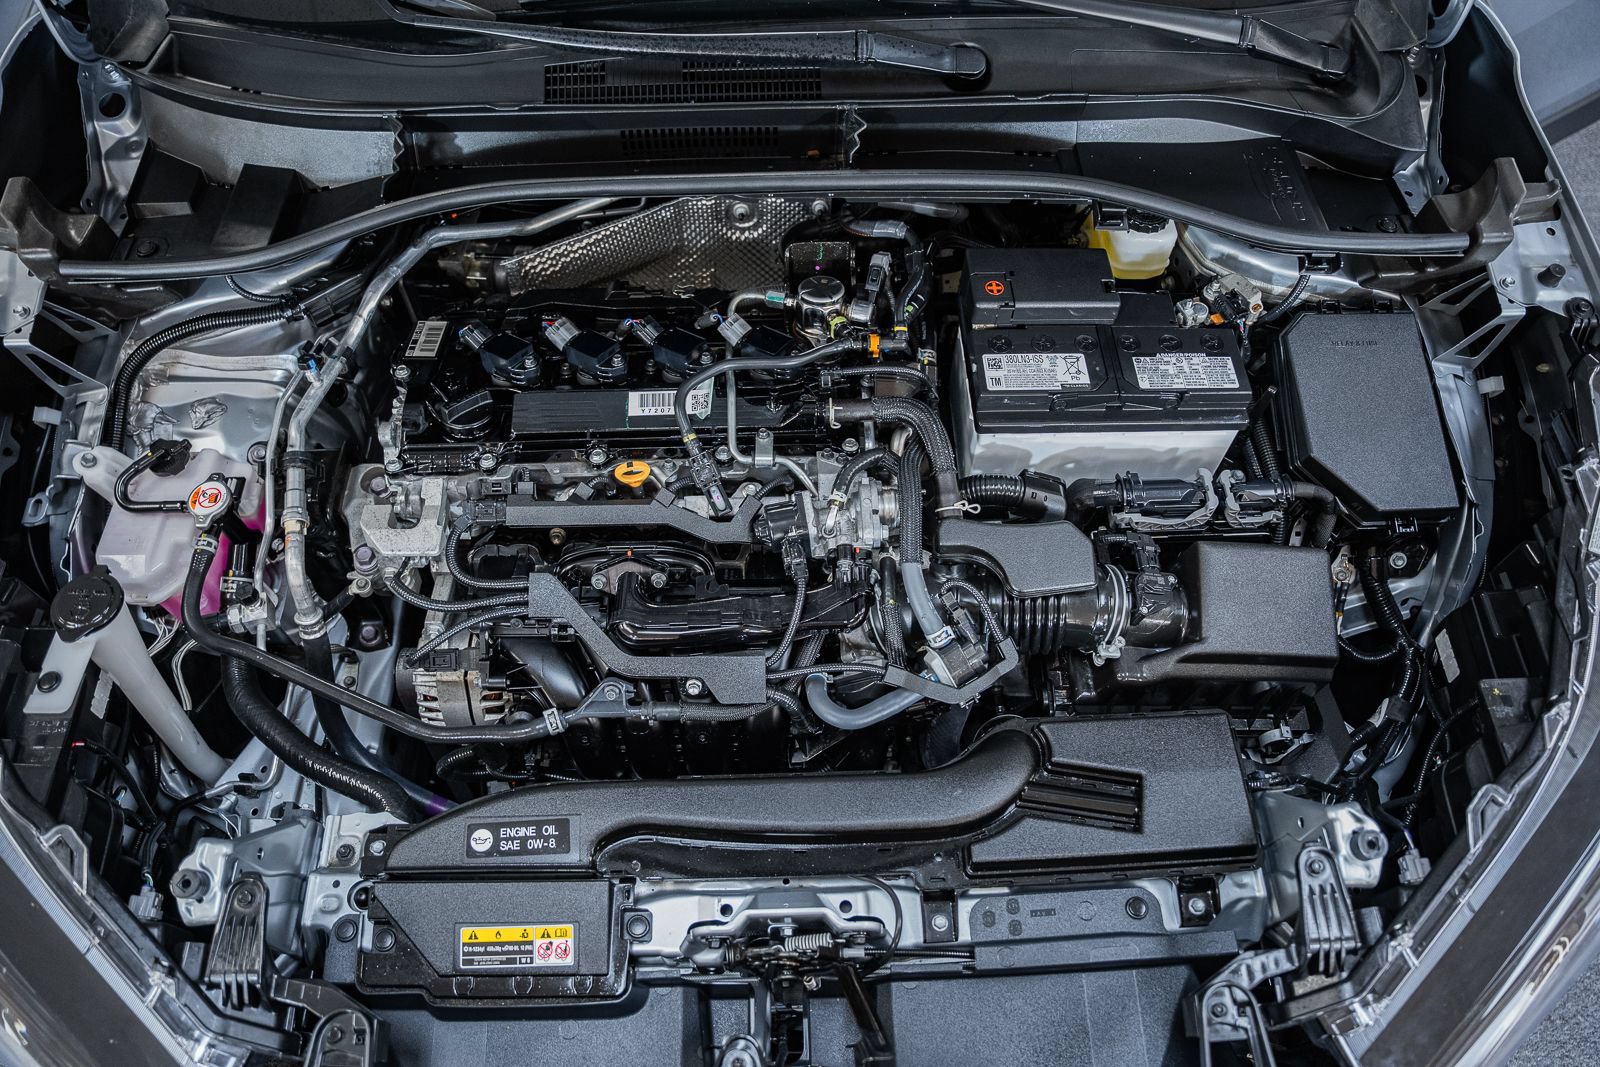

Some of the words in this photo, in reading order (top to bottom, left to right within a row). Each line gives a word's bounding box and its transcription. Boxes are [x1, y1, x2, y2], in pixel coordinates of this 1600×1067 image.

[989, 377, 1002, 387] TM
[500, 826, 537, 838] ENGINE
[542, 824, 559, 836] OIL
[499, 840, 520, 851] SAE
[527, 838, 556, 849] 0W-8
